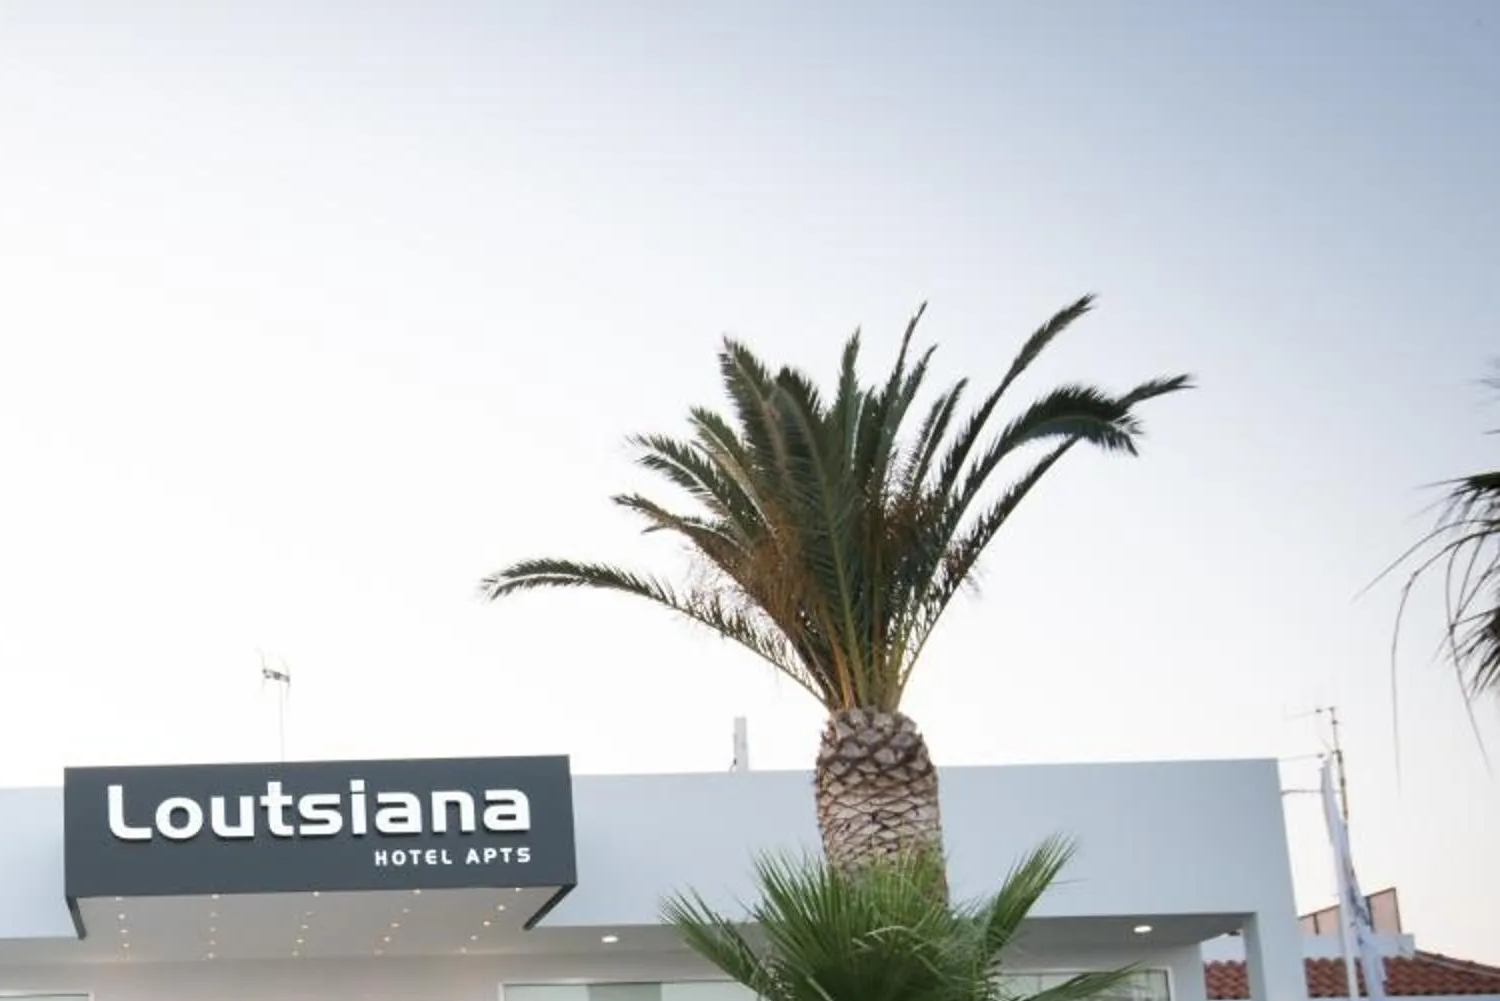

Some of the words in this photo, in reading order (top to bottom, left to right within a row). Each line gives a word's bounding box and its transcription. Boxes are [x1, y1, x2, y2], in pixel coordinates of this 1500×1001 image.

[107, 779, 531, 840] Loutsiana
[374, 849, 453, 866] HOTEL
[465, 847, 531, 864] APTS
